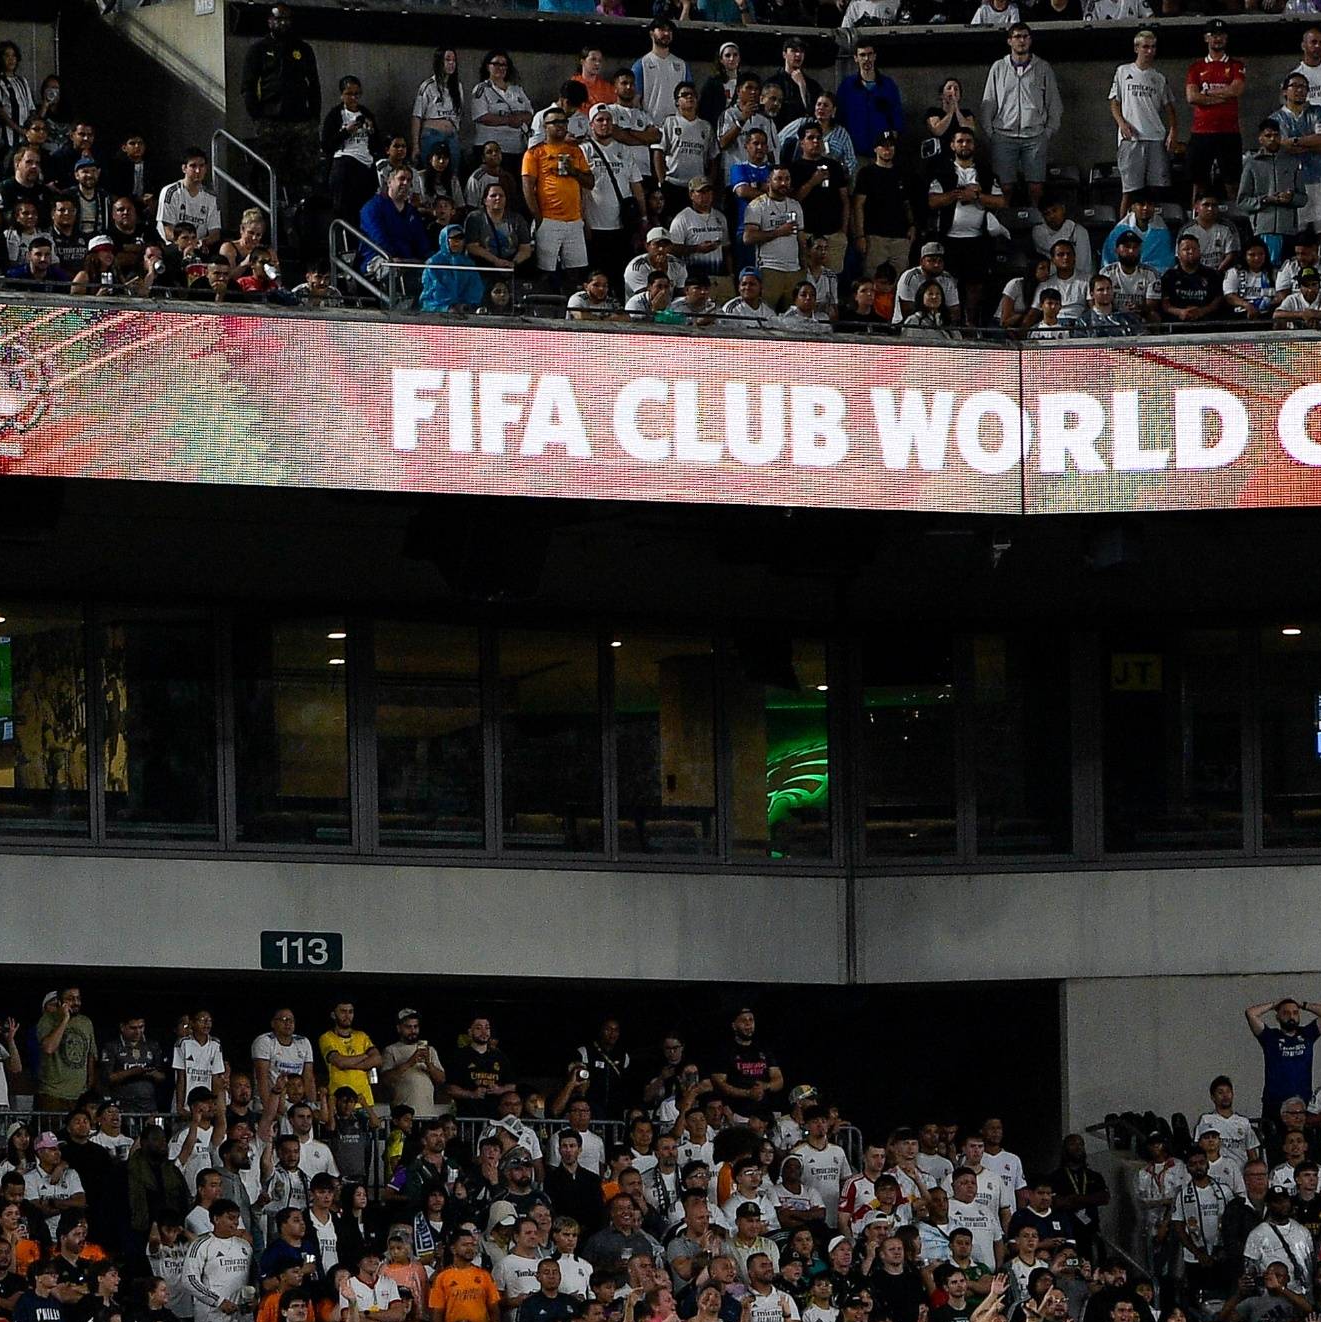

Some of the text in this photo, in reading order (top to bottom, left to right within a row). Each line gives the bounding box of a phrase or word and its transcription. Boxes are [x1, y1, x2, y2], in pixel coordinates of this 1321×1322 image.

[389, 367, 593, 460] FIFA
[614, 376, 852, 467] CLUB
[870, 386, 1249, 475] WORLD
[274, 936, 329, 966] 113
